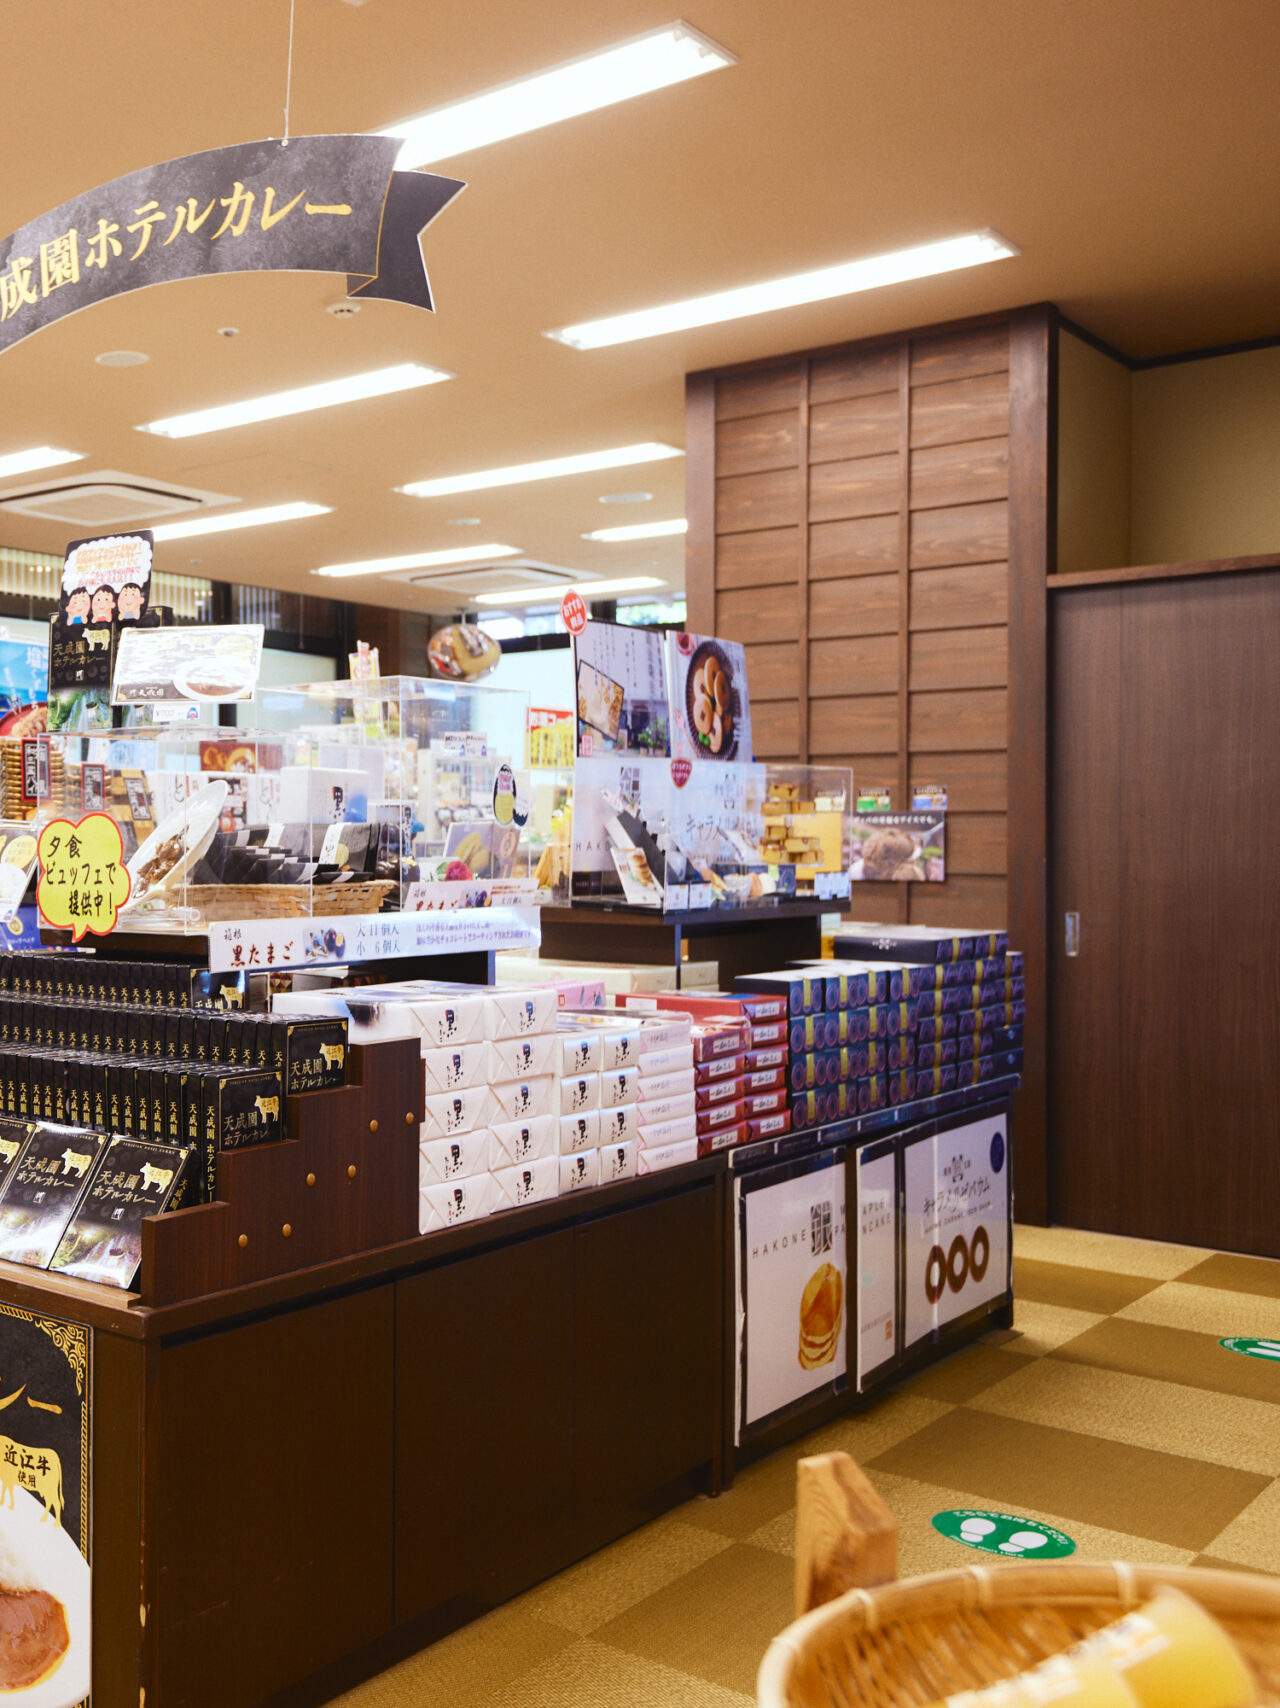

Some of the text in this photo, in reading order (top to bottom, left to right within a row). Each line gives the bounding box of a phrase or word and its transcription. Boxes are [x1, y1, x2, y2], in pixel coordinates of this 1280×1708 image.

[47, 834, 84, 859] 夕食
[45, 861, 118, 887] ビュッフェで
[224, 927, 243, 941] 箱根
[230, 940, 294, 967] 黒たまご
[290, 1058, 322, 1076] 天成園
[223, 1110, 258, 1131] 天成園
[21, 1156, 62, 1174] 天成園
[96, 1170, 141, 1190] 天成園
[752, 1229, 807, 1259] HAKONE
[3, 1444, 52, 1476] 近江牛
[17, 1470, 37, 1488] 使用
